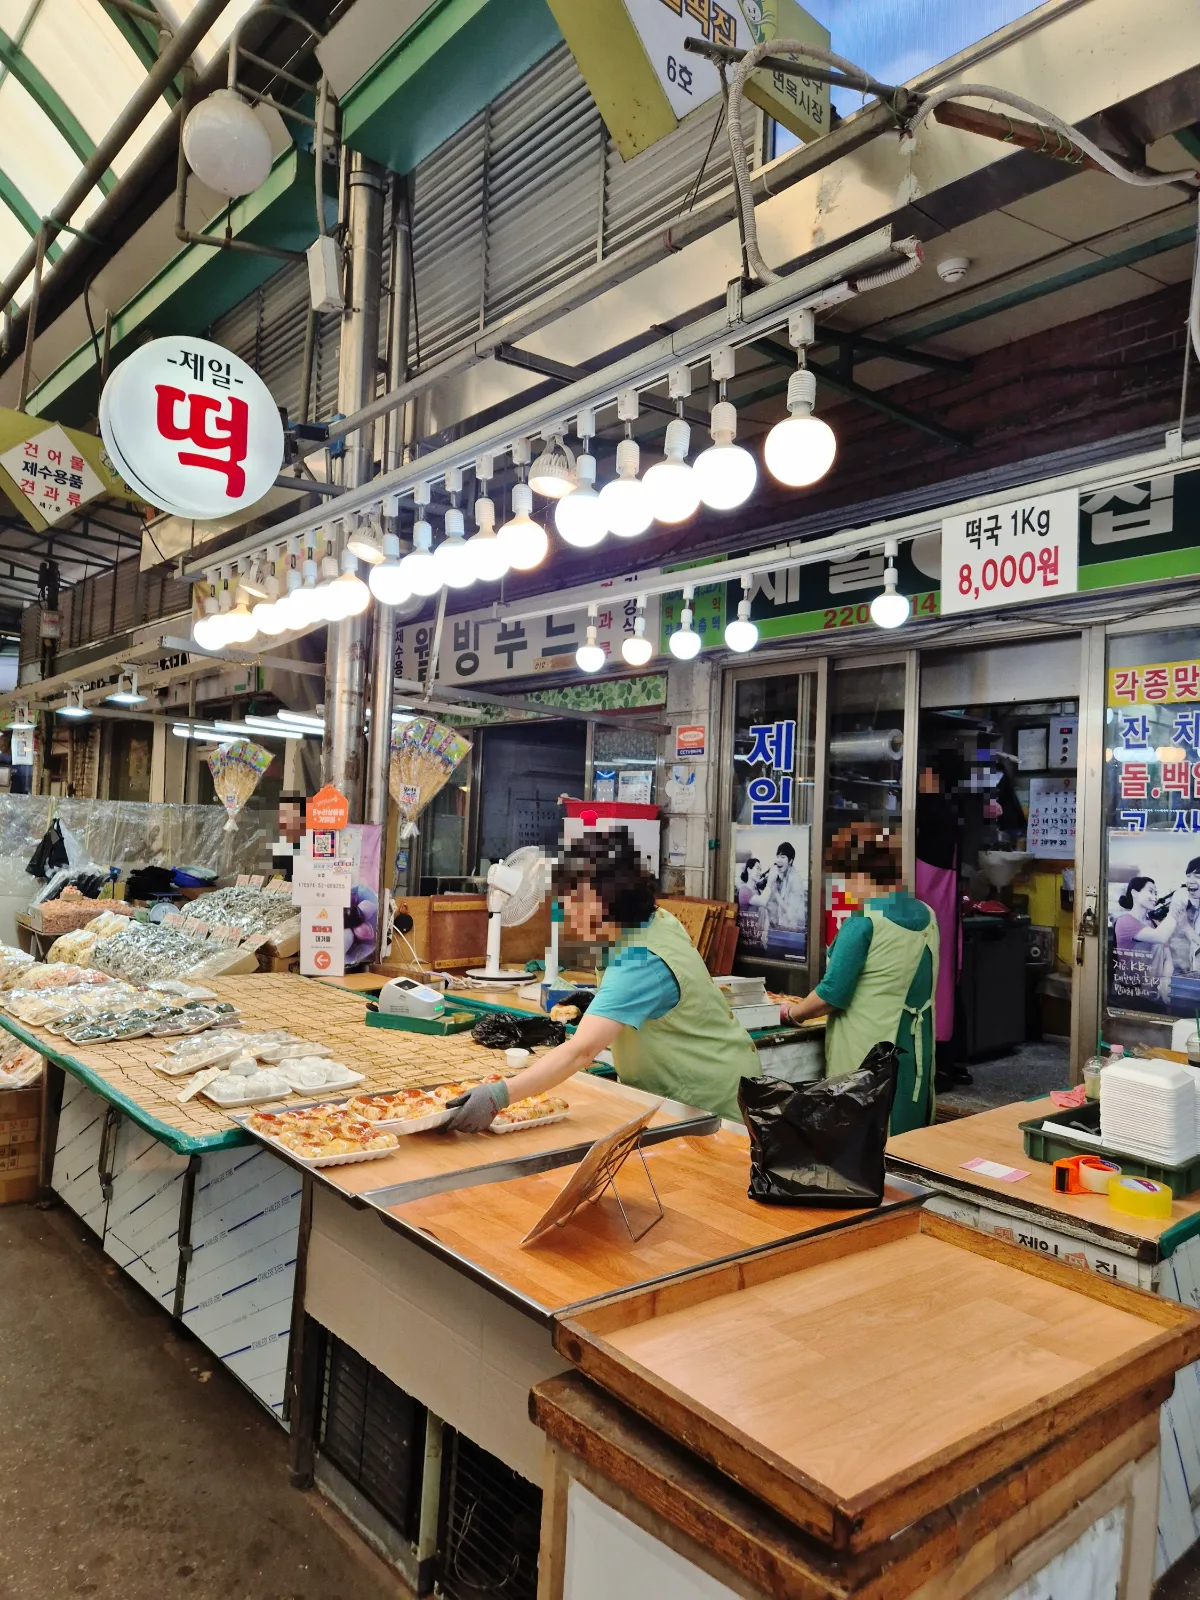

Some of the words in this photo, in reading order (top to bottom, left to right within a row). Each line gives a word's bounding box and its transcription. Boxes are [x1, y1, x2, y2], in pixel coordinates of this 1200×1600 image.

[667, 55, 693, 96] 6호
[772, 70, 823, 125] 면목시장
[154, 384, 249, 498] 떡
[22, 460, 84, 490] 제수용품
[966, 514, 1002, 550] 떡국
[1011, 506, 1051, 538] 1Kg
[958, 545, 1060, 600] 8,000원
